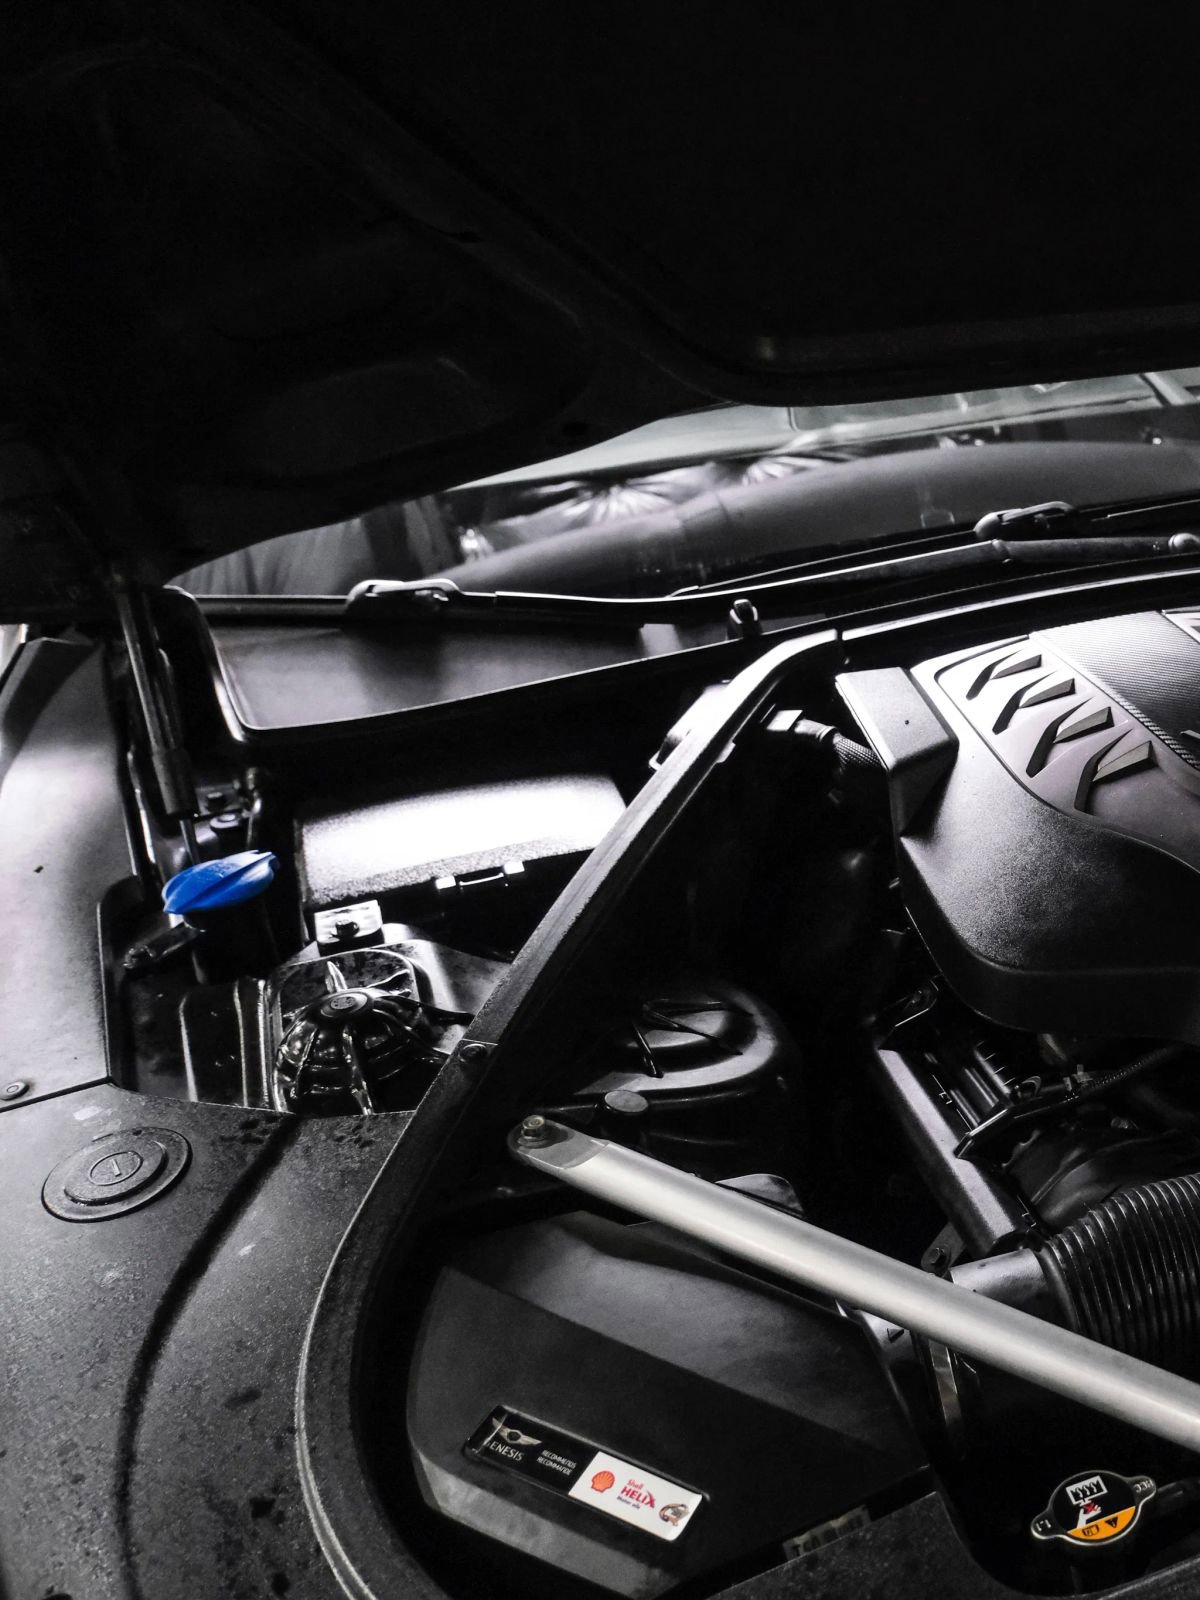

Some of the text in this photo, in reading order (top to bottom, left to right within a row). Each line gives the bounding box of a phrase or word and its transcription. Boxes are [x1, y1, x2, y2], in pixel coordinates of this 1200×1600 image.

[486, 1440, 525, 1461] ENESIS
[626, 1479, 644, 1490] Shell
[620, 1486, 655, 1509] HELIX
